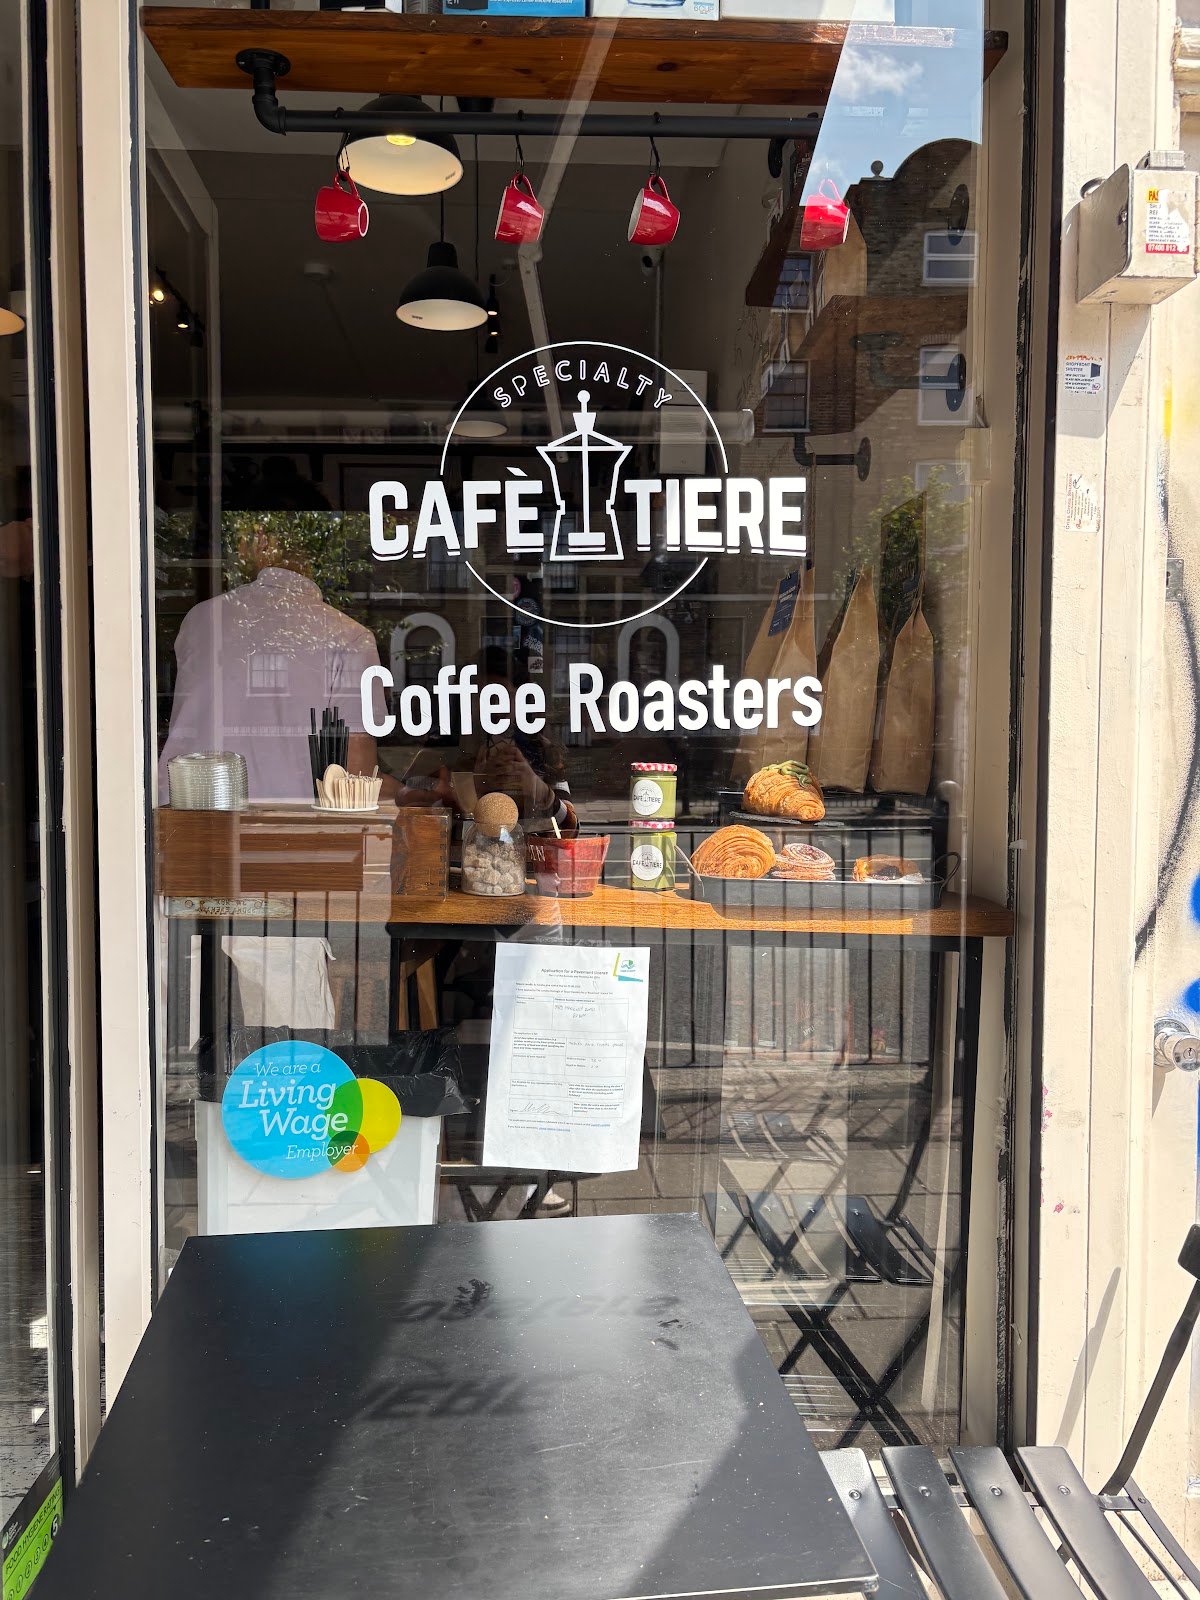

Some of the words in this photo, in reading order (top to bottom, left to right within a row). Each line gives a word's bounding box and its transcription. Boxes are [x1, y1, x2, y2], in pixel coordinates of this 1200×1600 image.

[492, 359, 673, 408] SPECIALTY
[369, 466, 545, 561] CAFÈ
[624, 477, 807, 557] TIERE
[360, 665, 546, 738] Coffee
[568, 662, 823, 734] Roasters
[254, 1062, 279, 1077] We
[282, 1065, 307, 1076] are
[311, 1062, 321, 1073] a
[237, 1079, 337, 1110] Living
[258, 1107, 349, 1140] Wage
[285, 1142, 359, 1162] Employer
